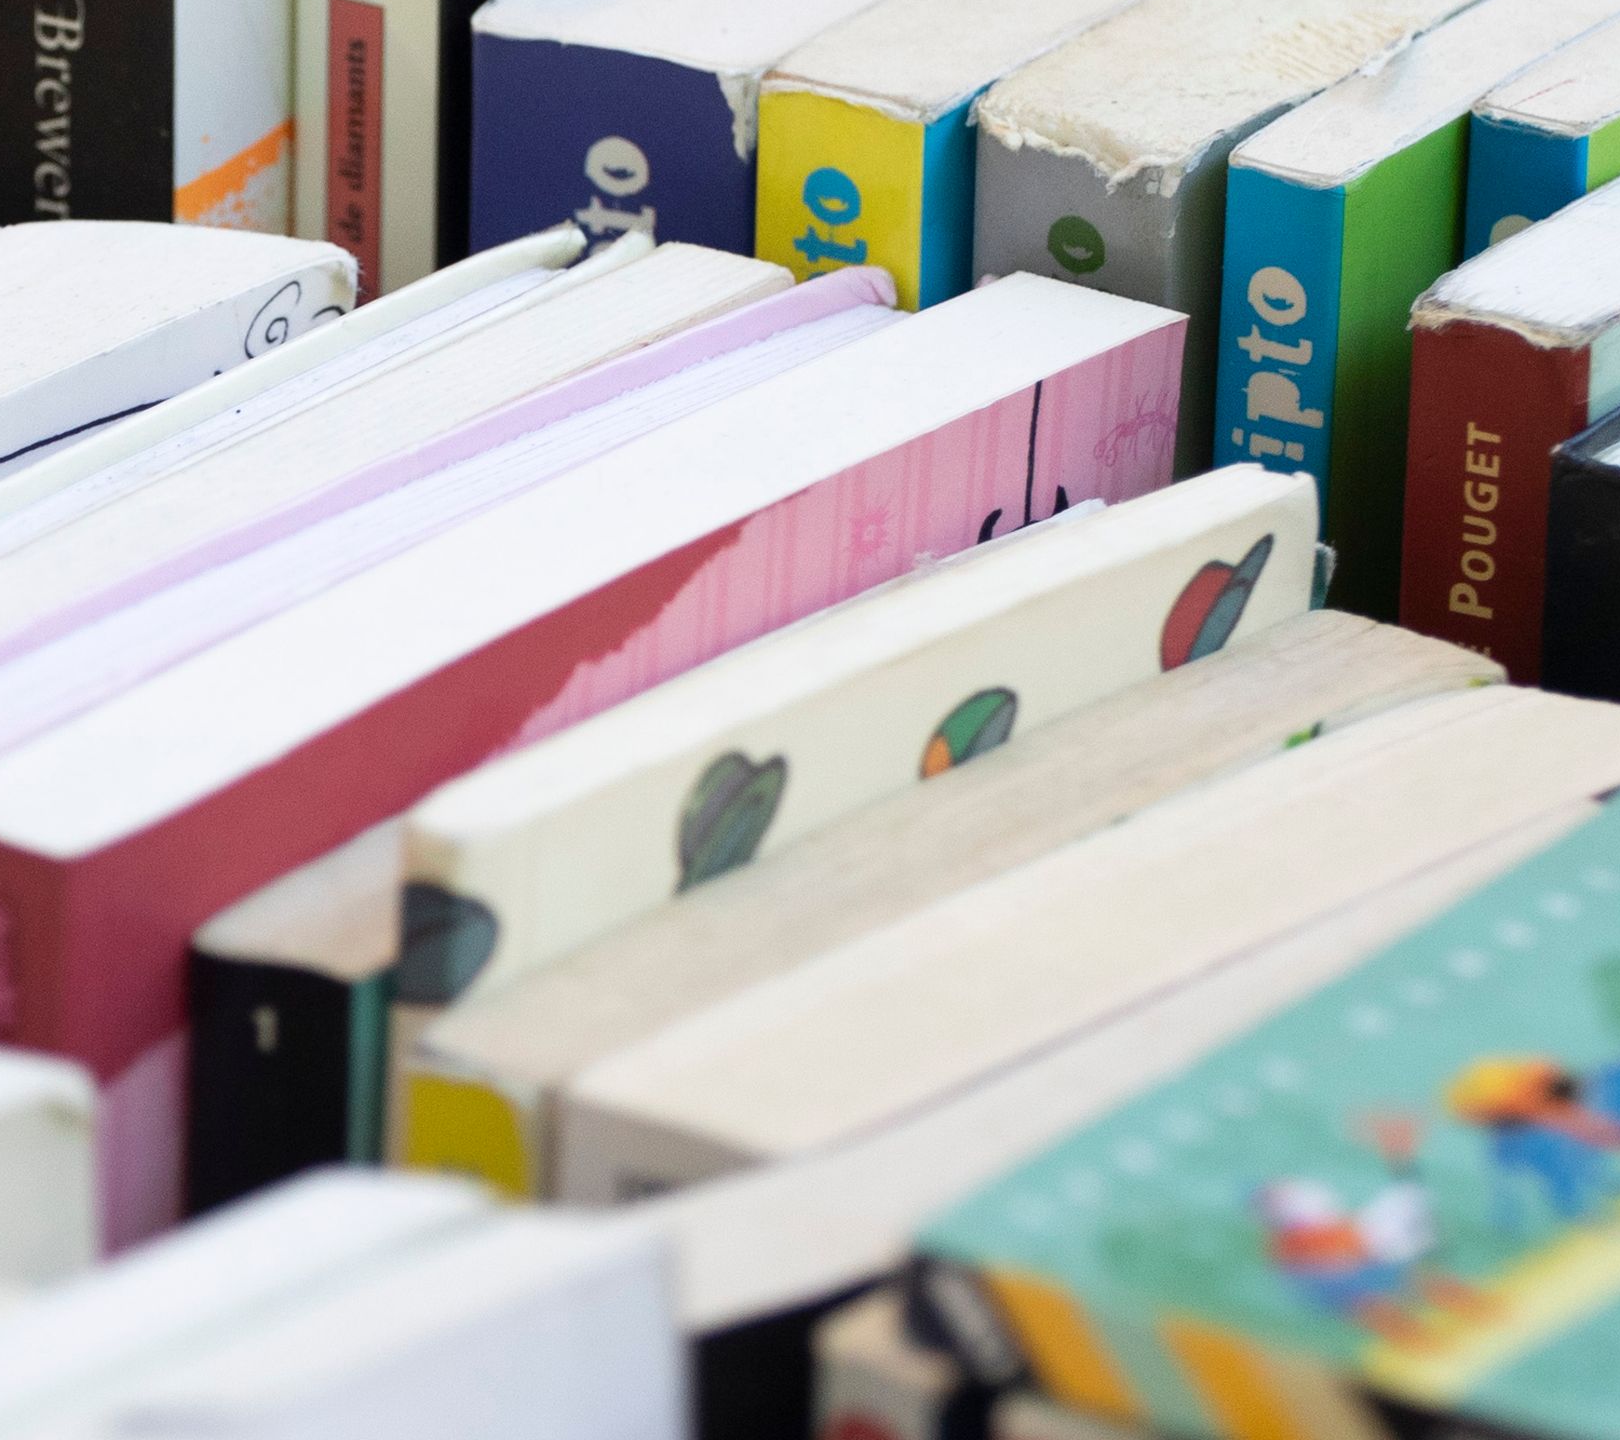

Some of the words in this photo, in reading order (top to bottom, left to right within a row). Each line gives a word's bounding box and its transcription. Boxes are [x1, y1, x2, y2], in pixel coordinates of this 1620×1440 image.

[574, 135, 657, 254] to
[793, 166, 870, 276] to
[1448, 421, 1503, 620] POUGET
